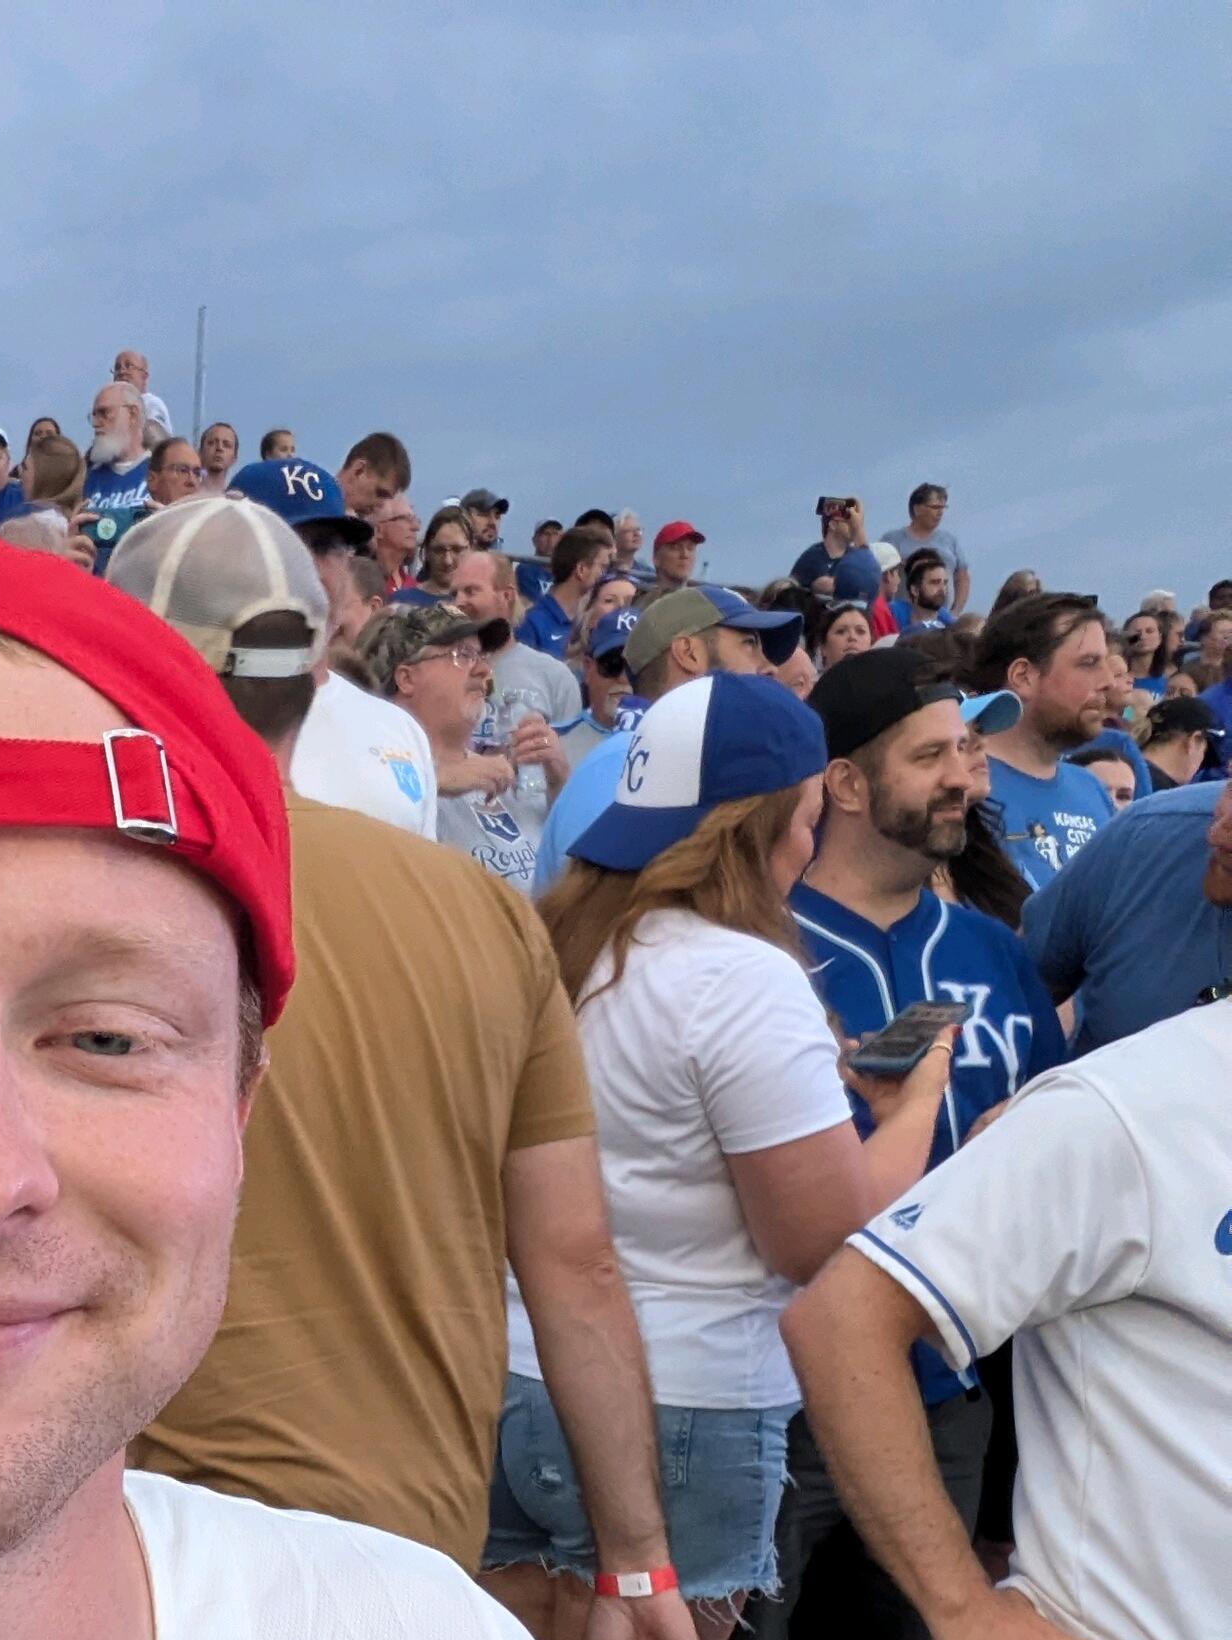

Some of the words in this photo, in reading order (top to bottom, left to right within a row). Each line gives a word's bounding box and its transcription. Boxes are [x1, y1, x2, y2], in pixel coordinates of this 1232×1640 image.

[280, 464, 324, 501] KC
[1053, 812, 1096, 832] KANSAS
[471, 841, 536, 880] Royal
